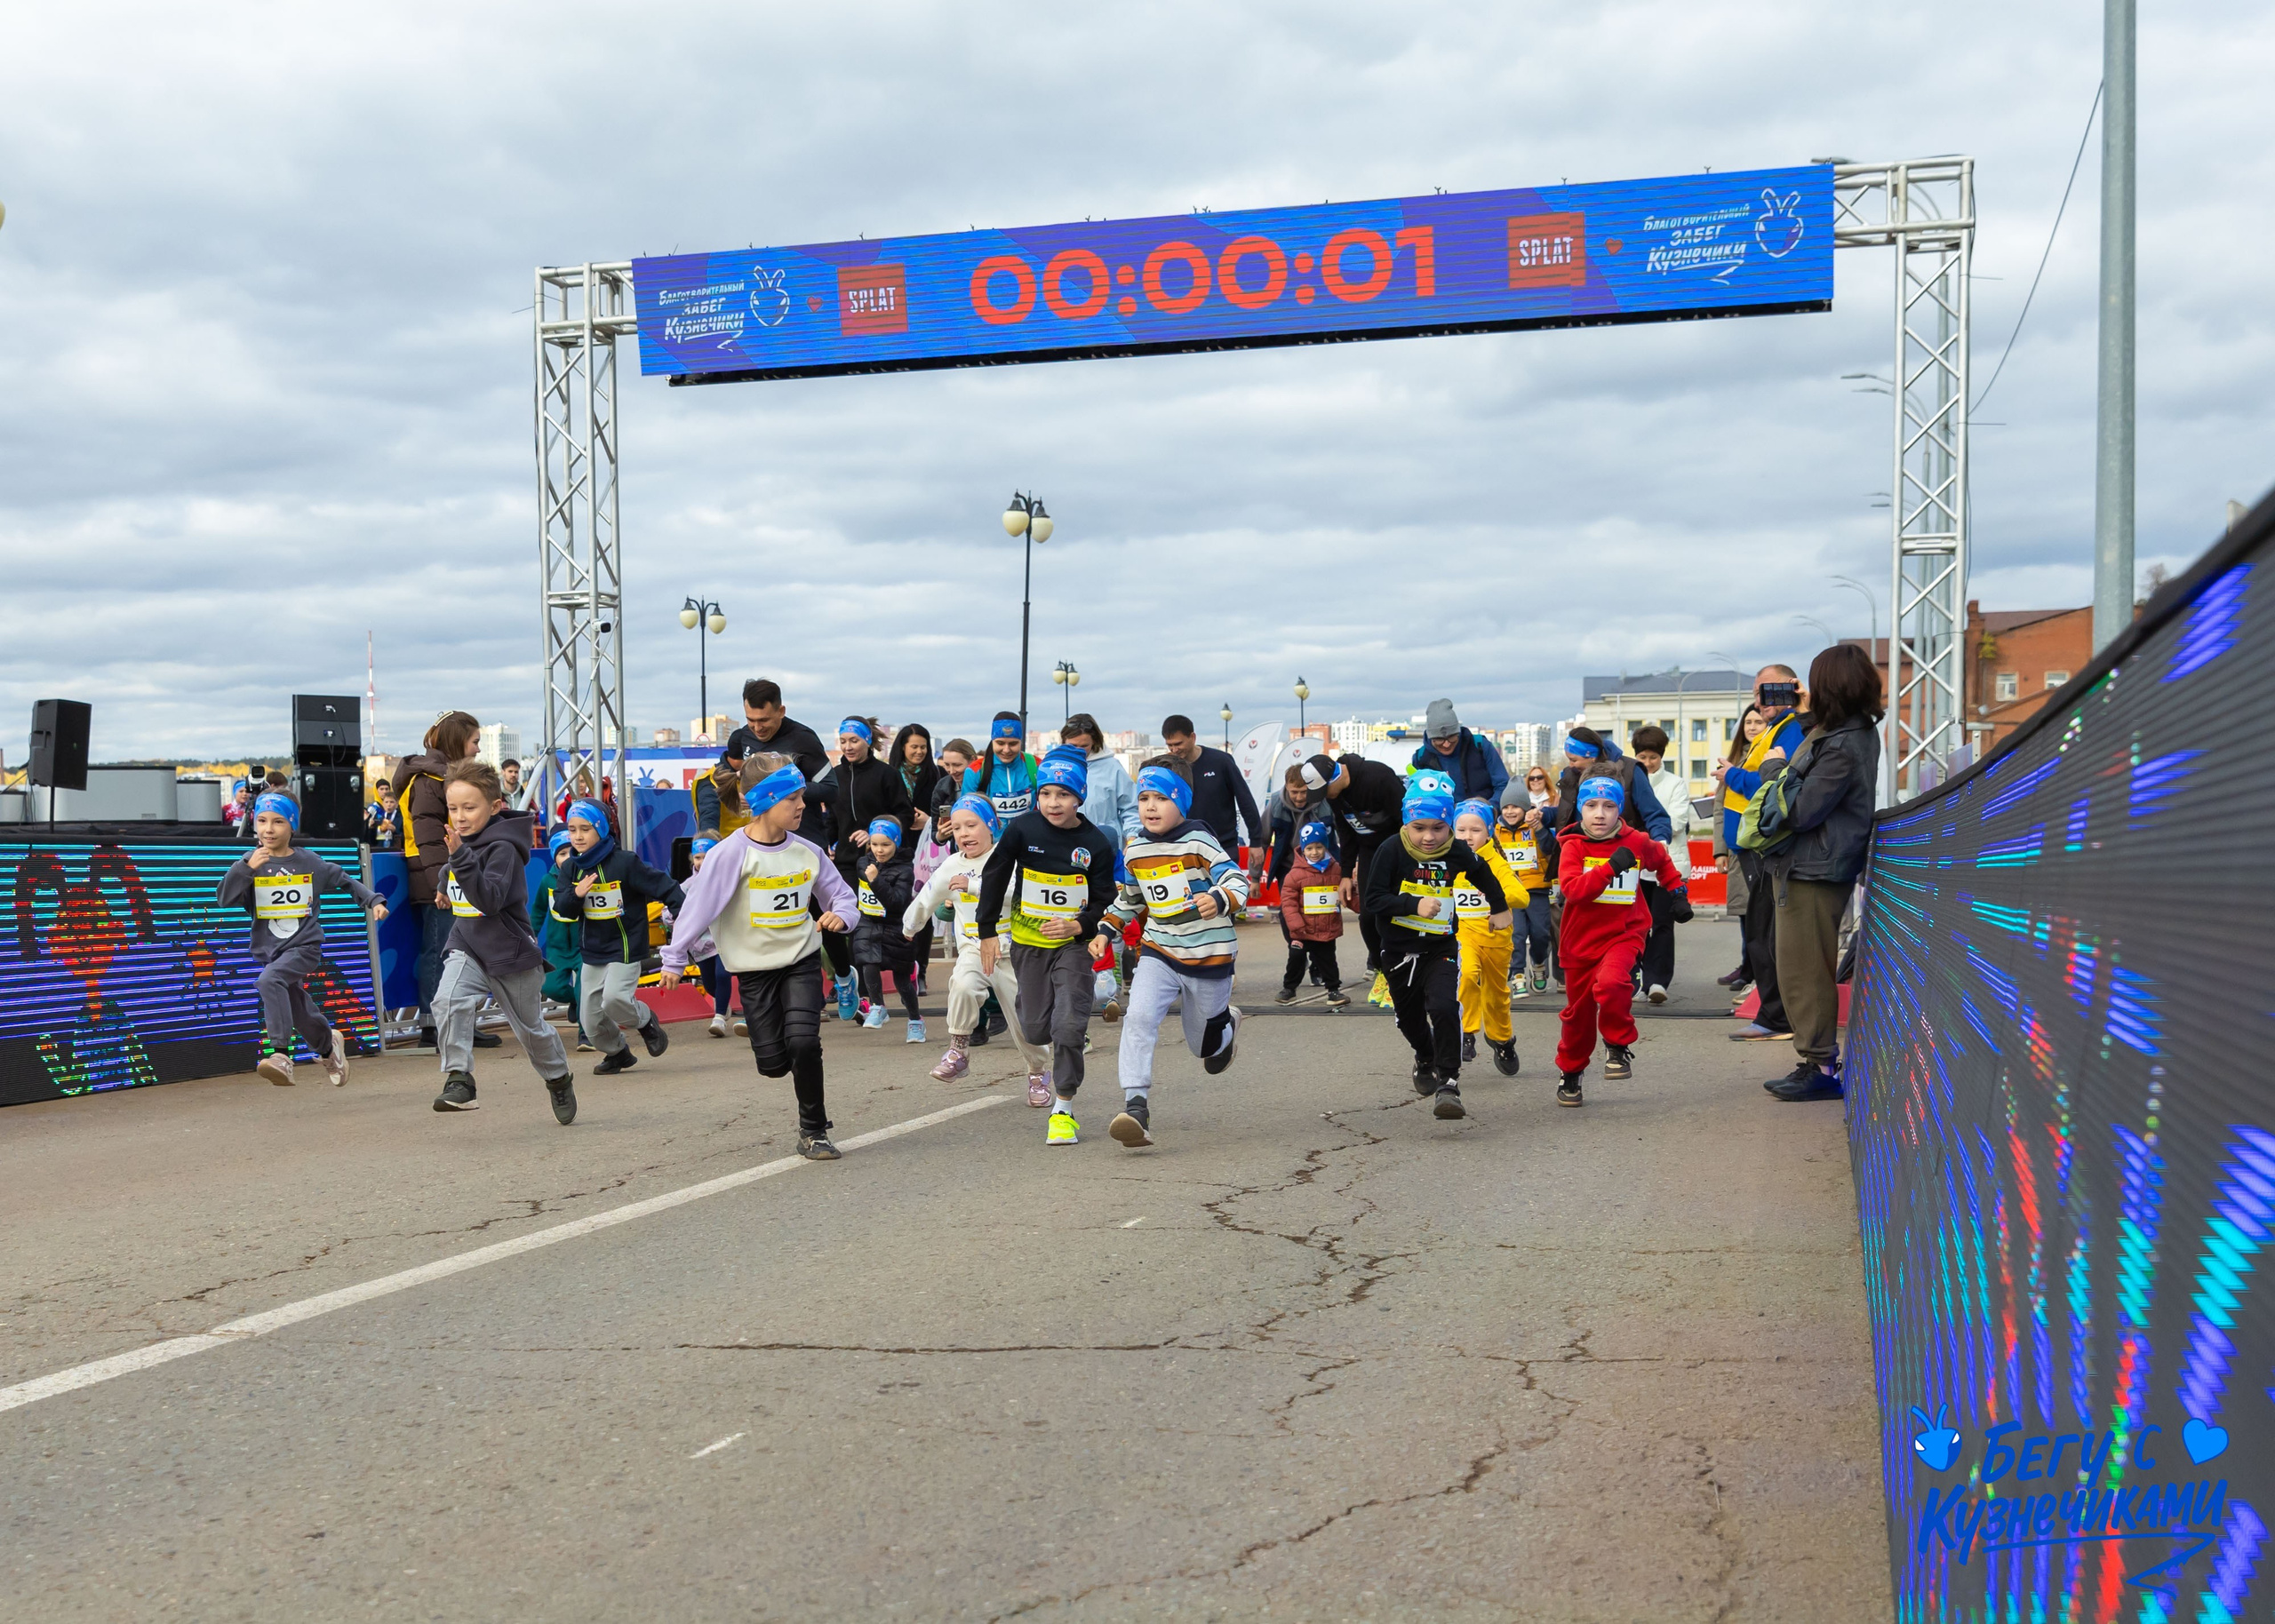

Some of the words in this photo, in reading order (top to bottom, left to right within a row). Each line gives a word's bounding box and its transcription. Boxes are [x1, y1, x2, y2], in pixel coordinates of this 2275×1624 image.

[1670, 224, 1726, 246] ЗАБЕГ
[1519, 236, 1574, 266] SPLAT
[970, 226, 1437, 325] 00:00:01
[682, 298, 726, 315] ЗАБЕГ
[849, 287, 896, 313] SPLAT
[998, 798, 1027, 810] 442
[1510, 851, 1525, 861] 12
[271, 889, 301, 904] 20
[451, 886, 462, 901] 17
[862, 892, 877, 904] 28
[1041, 889, 1067, 905] 16
[1147, 884, 1169, 901] 19
[1319, 895, 1328, 904] 5
[1457, 893, 1481, 906] 25
[588, 896, 607, 907] 13
[773, 891, 799, 911] 21
